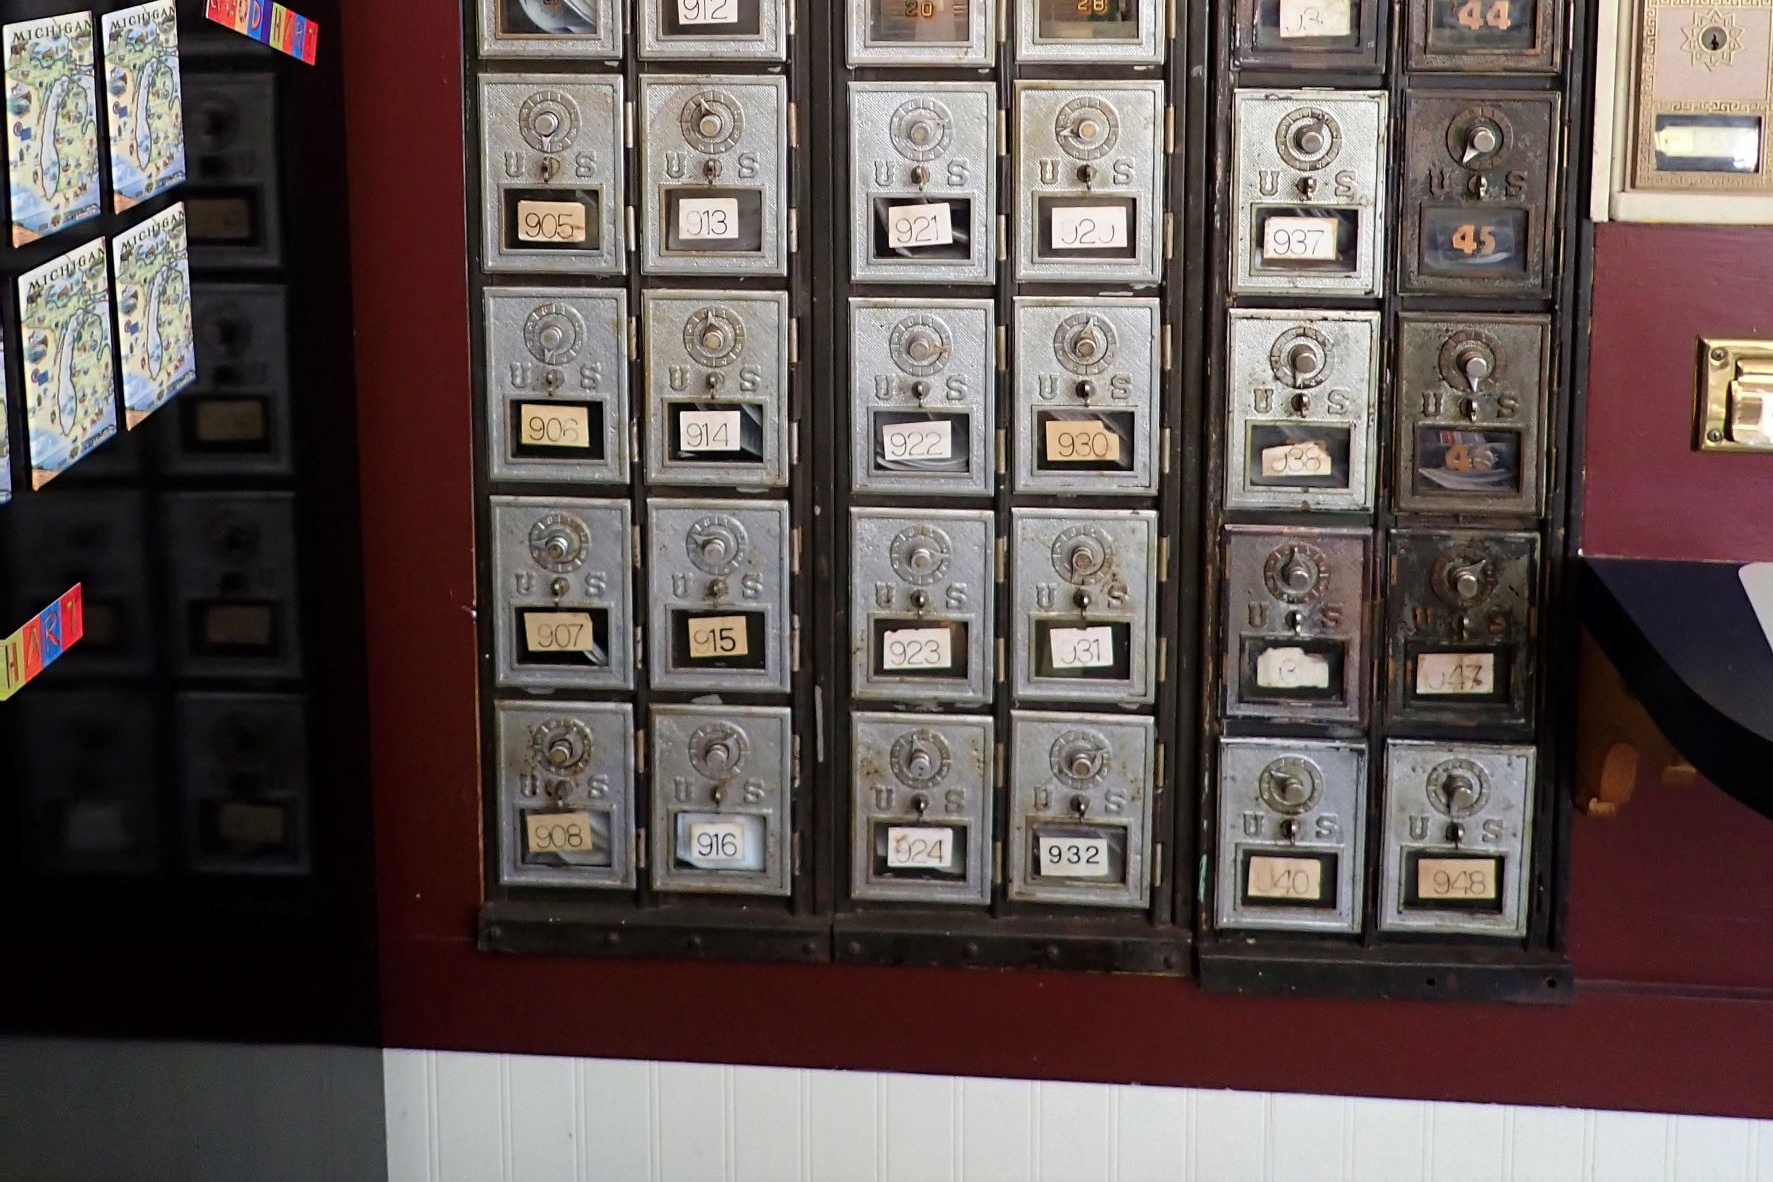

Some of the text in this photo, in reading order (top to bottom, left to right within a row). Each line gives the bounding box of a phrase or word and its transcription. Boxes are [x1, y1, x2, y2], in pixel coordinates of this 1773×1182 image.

[110, 5, 176, 31] MICHIGAN
[905, 0, 935, 19] 20
[1458, 0, 1511, 30] 44
[11, 18, 92, 42] MICHIGAN
[505, 153, 596, 177] U S
[666, 152, 759, 178] U S
[875, 160, 968, 185] U S
[1040, 159, 1135, 185] U S
[1259, 171, 1356, 197] U S
[1429, 170, 1527, 196] U S
[120, 211, 185, 252] MICHIGAN
[525, 212, 574, 239] 905
[686, 209, 727, 235] 913
[895, 215, 938, 242] 921
[1273, 229, 1324, 255] 937
[1452, 224, 1497, 254] 45
[28, 247, 106, 291] MICHIGAN
[510, 363, 602, 389] U S
[669, 366, 761, 391] U S
[875, 375, 967, 399] U S
[1038, 375, 1132, 400] U S
[1253, 389, 1350, 414] U S
[1422, 393, 1519, 418] U S
[529, 416, 578, 443] 906
[687, 422, 728, 447] 914
[890, 432, 942, 456] 922
[1058, 432, 1108, 457] 930
[515, 572, 607, 597] U S
[671, 574, 763, 598] U S
[875, 583, 966, 607] U S
[1036, 584, 1128, 607] U S
[1247, 603, 1343, 628] U S
[6, 597, 80, 689] HART
[537, 623, 583, 647] 907
[694, 628, 736, 652] 915
[890, 640, 941, 665] 923
[520, 774, 609, 798] U S
[673, 778, 765, 803] U S
[875, 787, 966, 811] U S
[1034, 787, 1126, 812] U S
[535, 824, 583, 848] 908
[1243, 812, 1339, 838] U S
[1409, 816, 1504, 842] U S
[697, 832, 737, 857] 916
[1048, 845, 1099, 865] 932
[1433, 870, 1485, 895] 948
